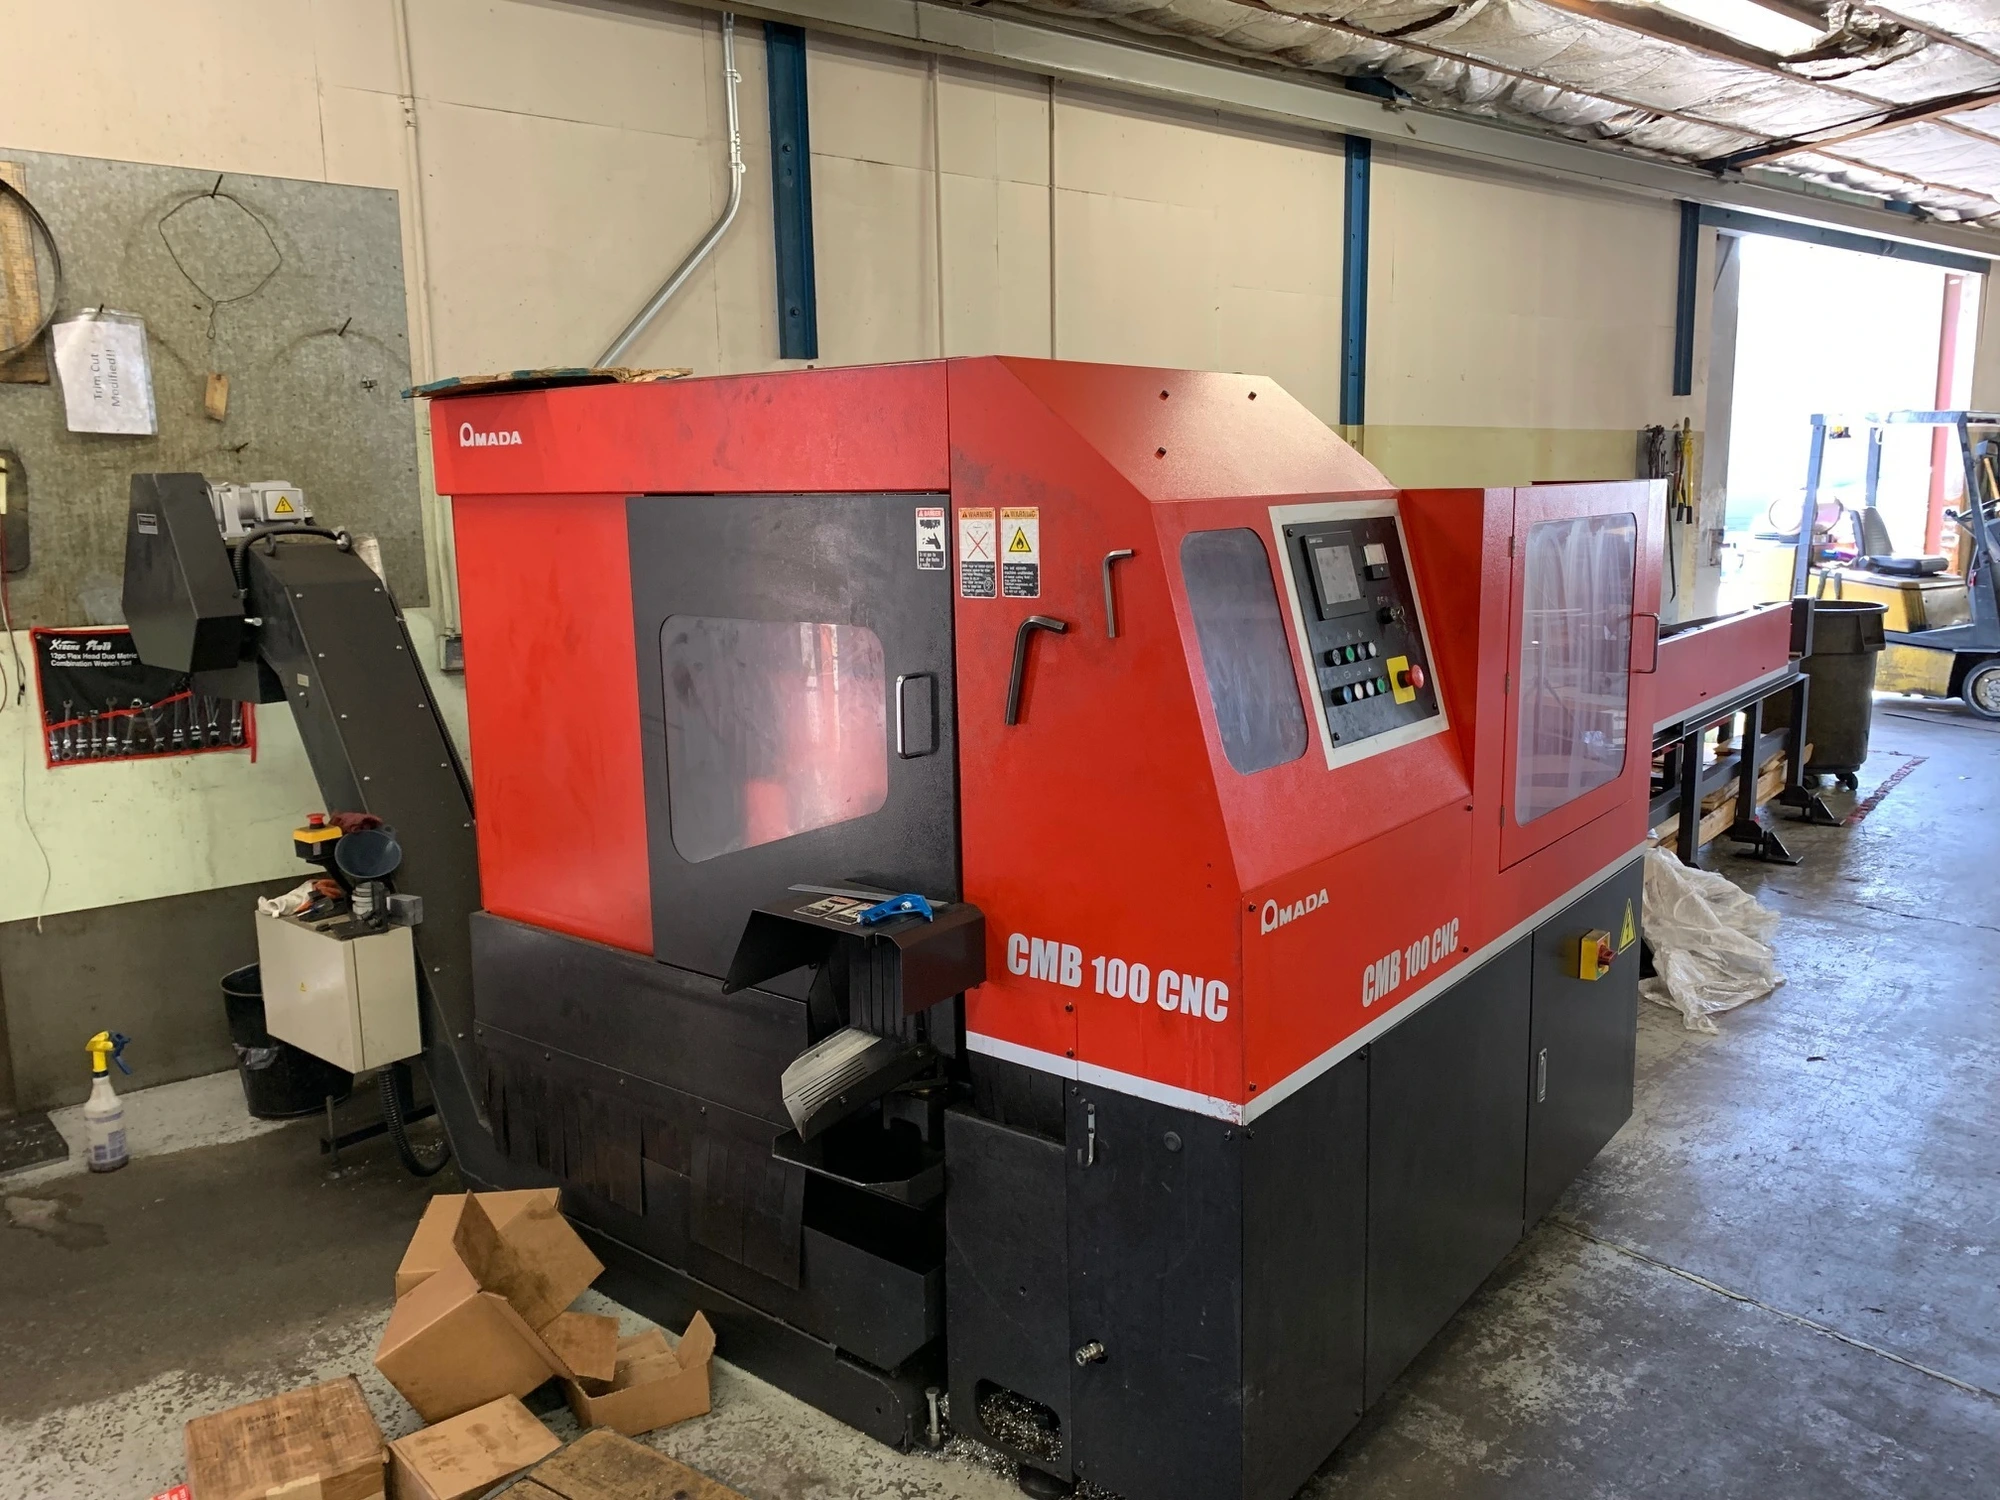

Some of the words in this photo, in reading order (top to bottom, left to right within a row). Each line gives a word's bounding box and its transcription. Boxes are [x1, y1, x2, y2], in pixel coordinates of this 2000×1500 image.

[91, 353, 100, 372] Cut
[94, 375, 103, 400] Trim
[459, 422, 522, 447] AMADA
[968, 510, 993, 518] WARNING
[1010, 510, 1036, 518] WARNING
[1261, 888, 1329, 936] AMADA
[1362, 949, 1401, 1008] CMB
[1404, 934, 1430, 982] 100
[1432, 917, 1459, 964] CNC
[1006, 932, 1083, 988] CMB
[1091, 955, 1150, 1004] 100
[1157, 969, 1229, 1023] CNC
